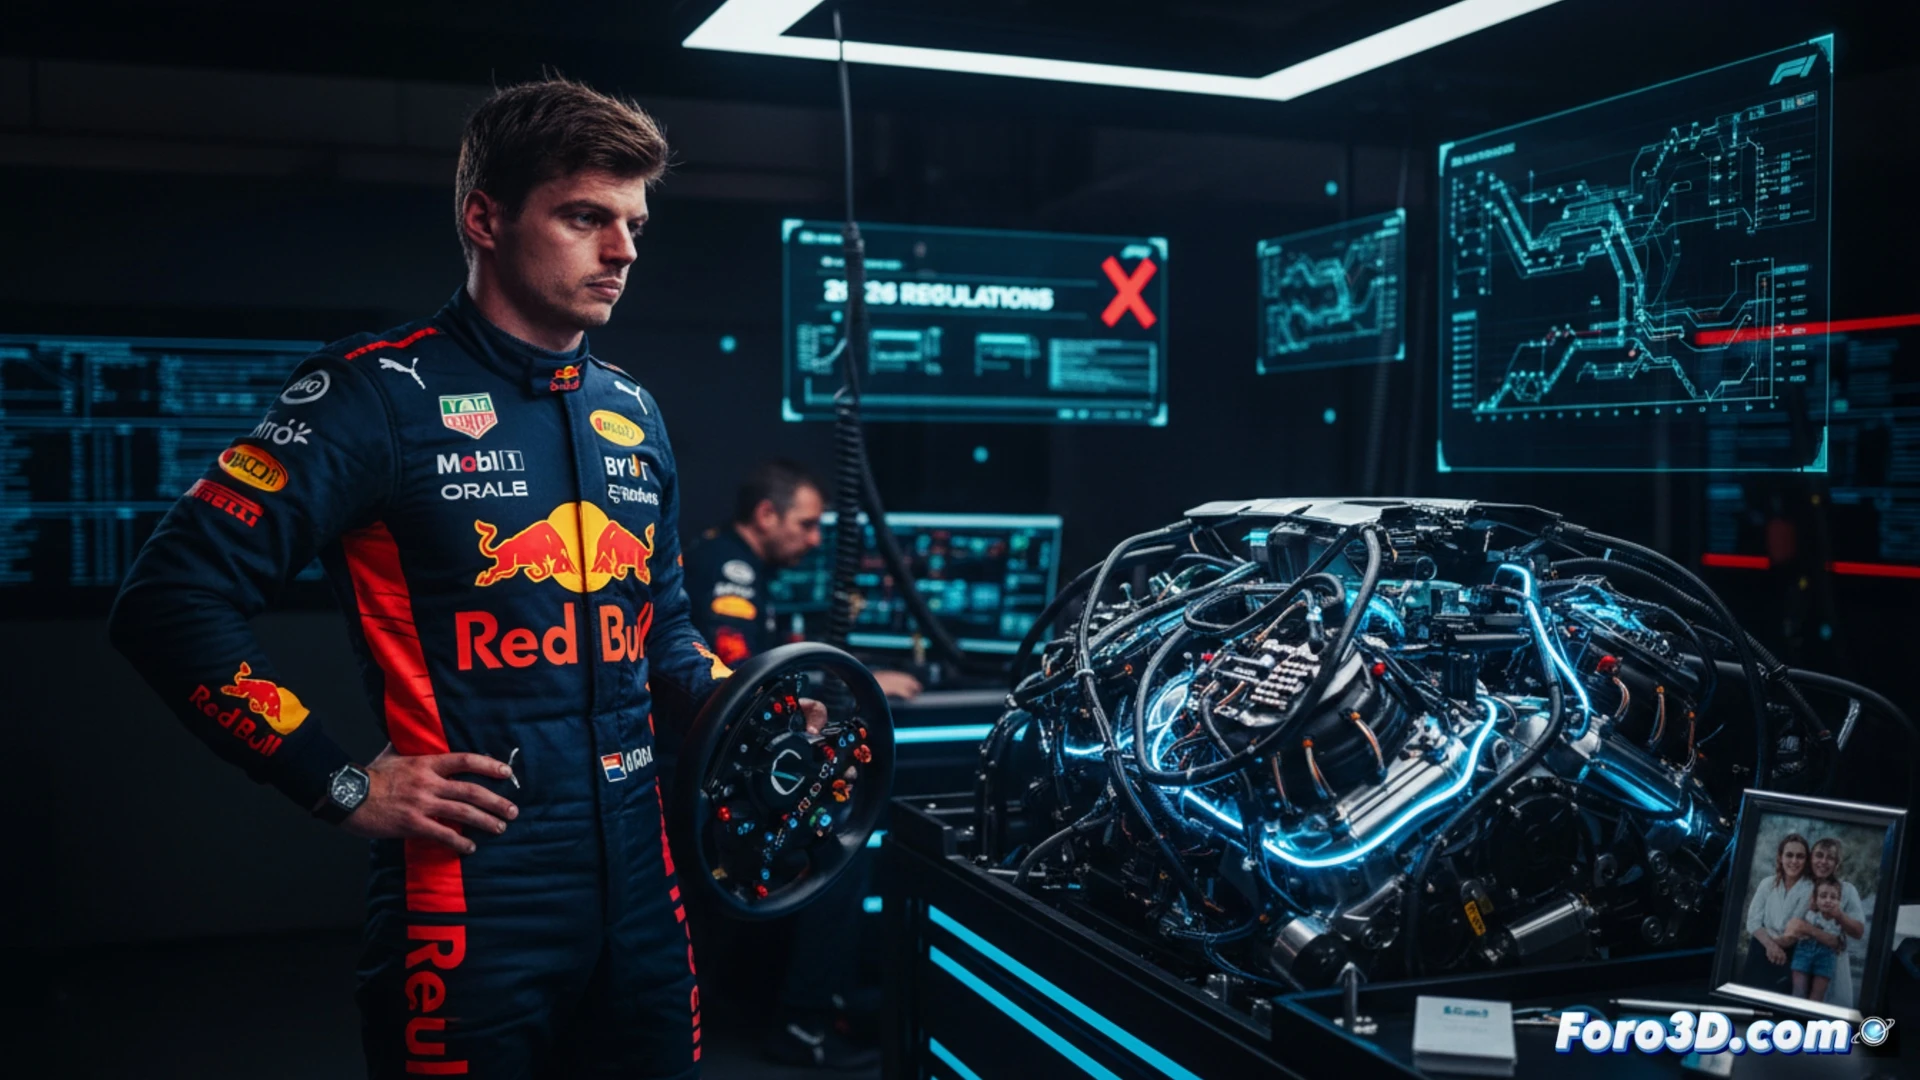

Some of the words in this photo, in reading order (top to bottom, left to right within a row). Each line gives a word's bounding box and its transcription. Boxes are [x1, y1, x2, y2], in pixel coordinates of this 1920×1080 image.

[899, 281, 1055, 311] REGULATIONS
[440, 480, 529, 500] ORALE
[455, 602, 578, 671] Red
[233, 716, 283, 757] Bull
